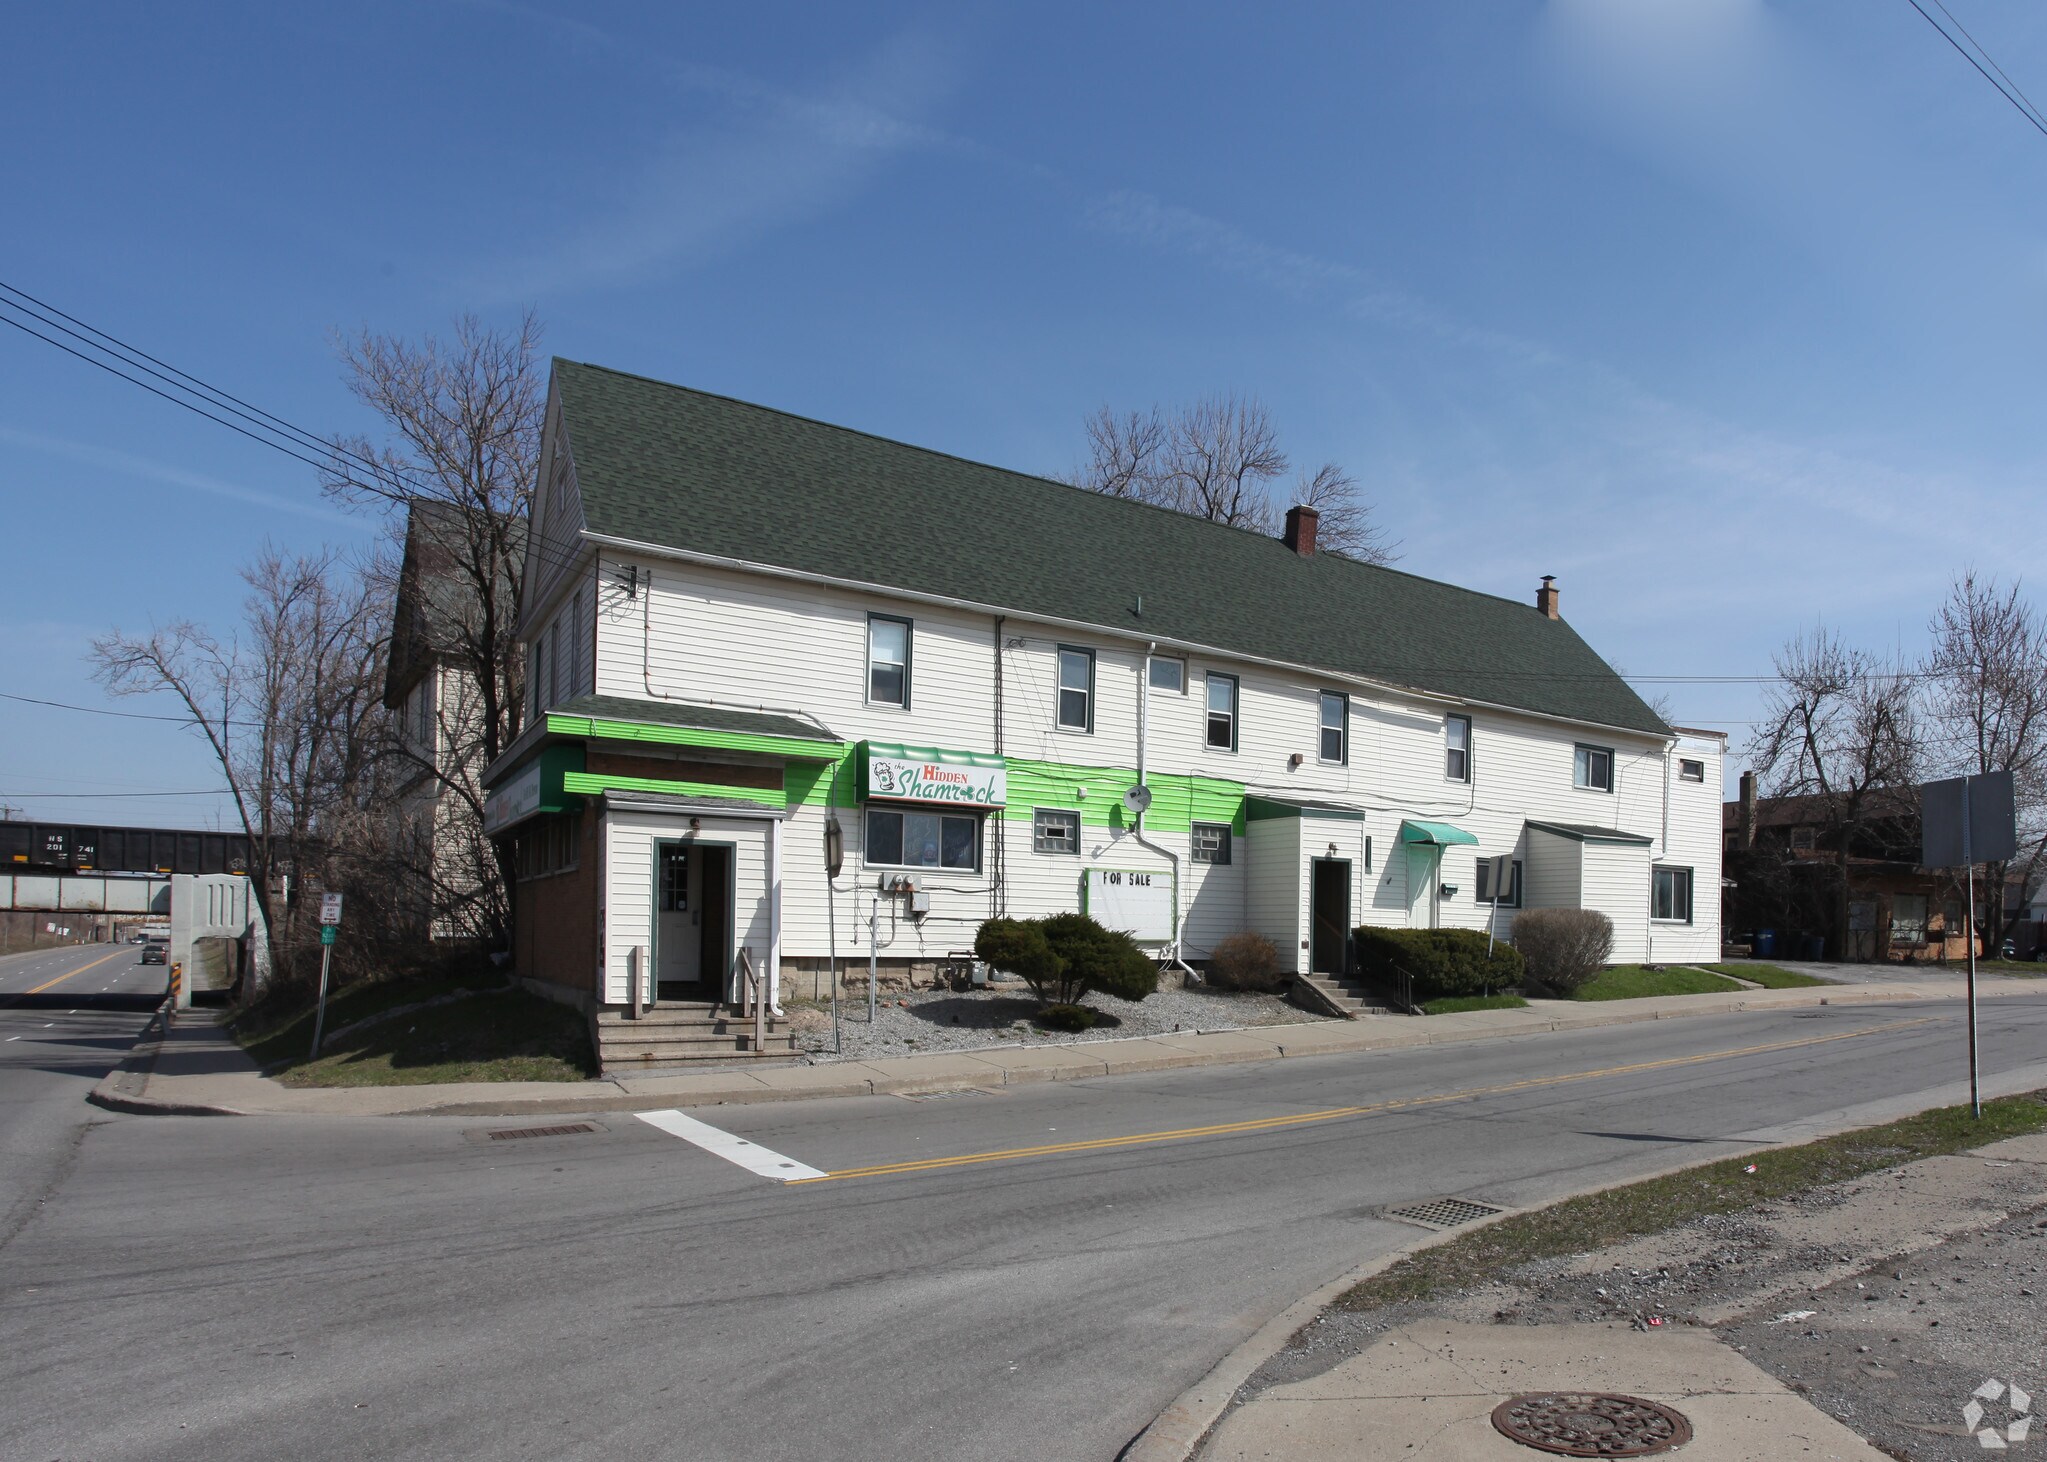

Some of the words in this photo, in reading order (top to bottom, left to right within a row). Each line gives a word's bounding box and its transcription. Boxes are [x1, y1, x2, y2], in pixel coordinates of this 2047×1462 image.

[894, 762, 905, 770] the
[46, 843, 63, 851] 201
[78, 845, 94, 853] 741
[1103, 871, 1121, 885] FOR
[1129, 872, 1151, 886] SALE
